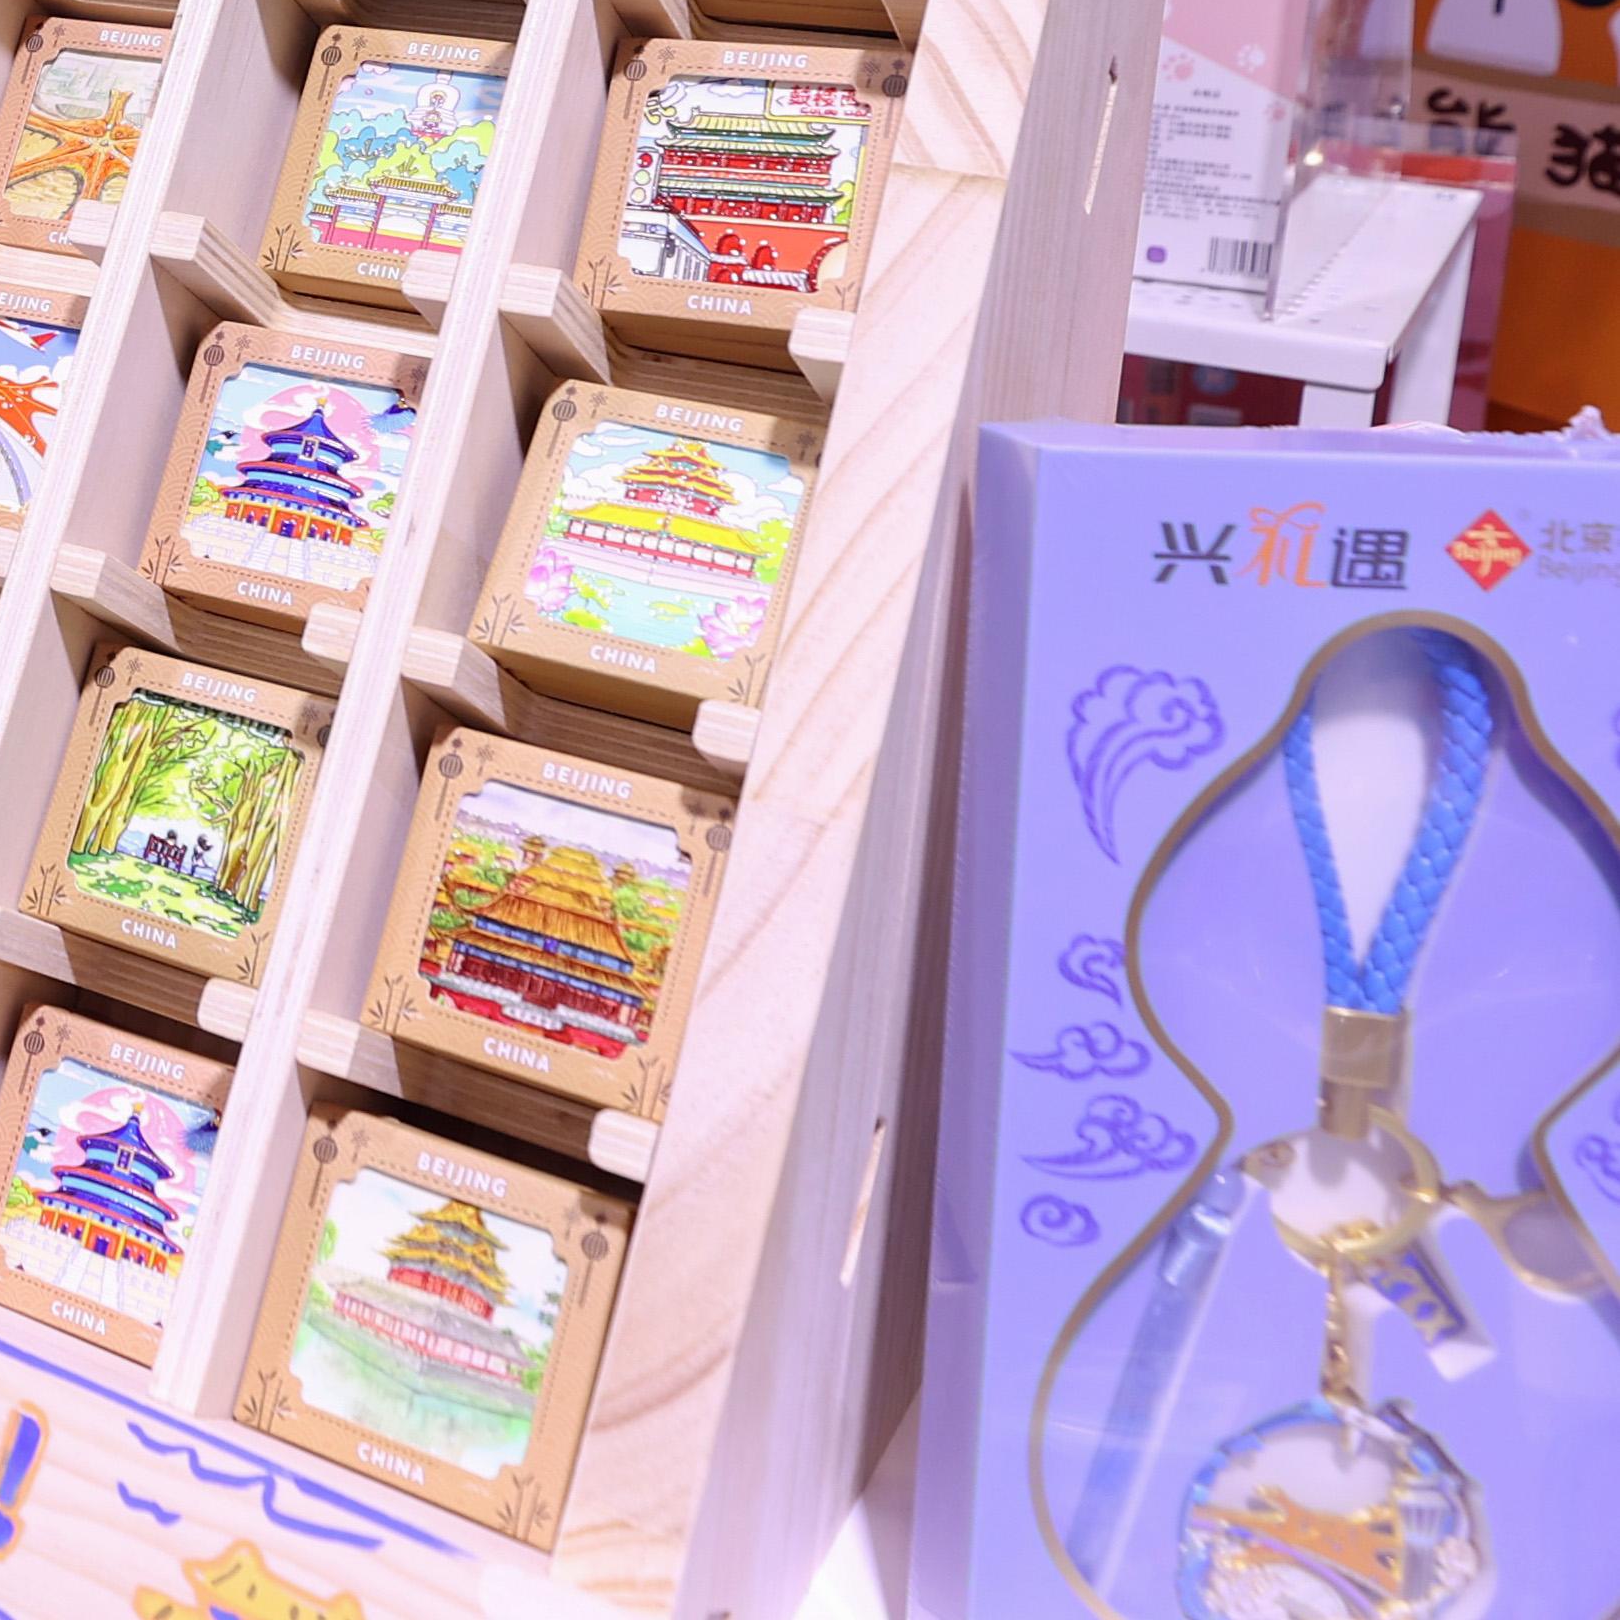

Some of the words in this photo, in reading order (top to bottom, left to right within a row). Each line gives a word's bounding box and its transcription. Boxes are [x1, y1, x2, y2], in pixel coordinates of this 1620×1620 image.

[99, 29, 162, 48] BEIJING
[407, 42, 481, 61] BEIJING
[722, 50, 809, 70] BEIJING
[356, 261, 402, 280] CHIN
[686, 294, 753, 316] CHINA
[290, 344, 366, 370] BEIJING
[655, 402, 745, 433] BEIJING
[236, 580, 295, 607] CHINA
[589, 643, 658, 674] CHINA
[180, 671, 258, 704] BEIJING
[541, 761, 633, 800] BEIJING
[120, 918, 179, 951] CHINA
[109, 1041, 186, 1081] BEIJING
[482, 1037, 551, 1074] CHINA
[416, 1151, 509, 1199] BEIJING
[50, 1300, 108, 1337] CHINA
[356, 1442, 426, 1486] CHINA
